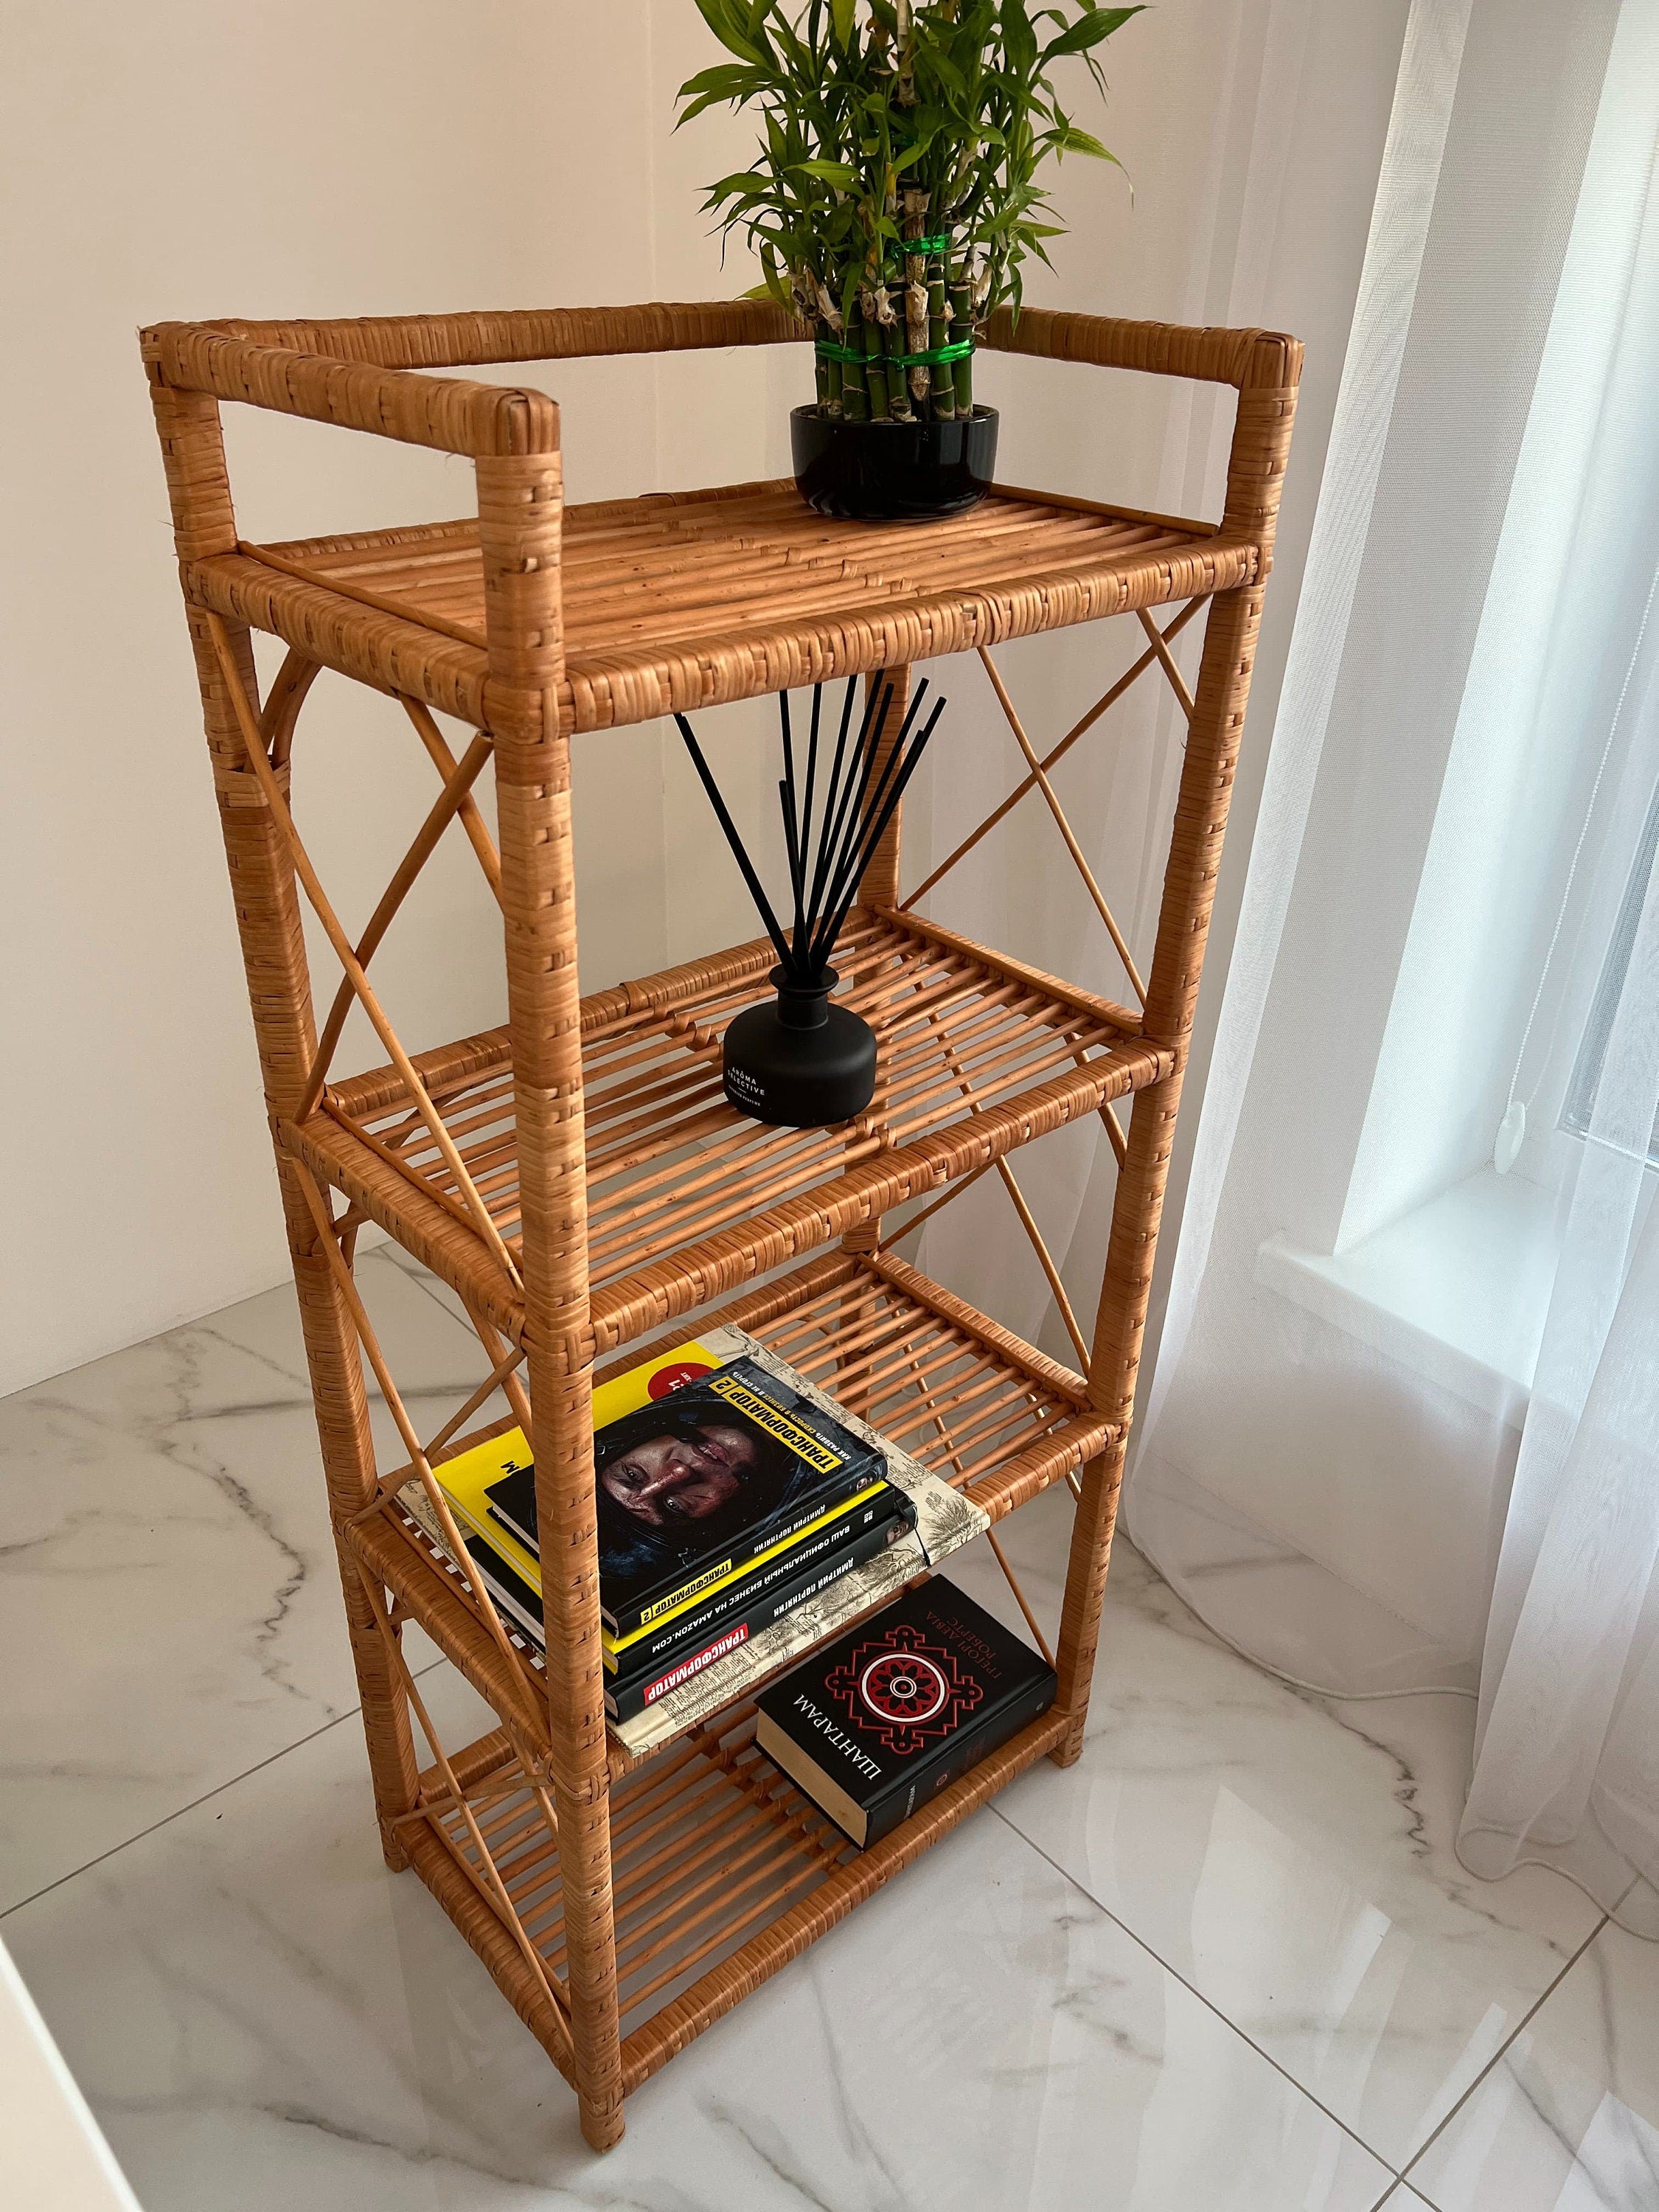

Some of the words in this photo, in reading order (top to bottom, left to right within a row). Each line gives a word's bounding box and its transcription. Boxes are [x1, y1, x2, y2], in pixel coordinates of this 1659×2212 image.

[727, 1069, 765, 1096] SELECTIVE
[716, 1380, 732, 1390] 2
[732, 1371, 754, 1387] СГОРЕТЬ
[751, 1383, 760, 1392] НЕ
[728, 1391, 835, 1470] ТРАНСФОРМАТОР
[790, 1413, 817, 1434] СКОРОСТЬ
[815, 1432, 841, 1453] РАЗВИТЬ
[838, 1450, 852, 1461] КАК
[754, 1526, 792, 1554] ПОРТНЯГИН
[831, 1525, 850, 1543] ВАШ
[764, 1538, 830, 1585] ОФИЦИАЛЬНЫЙ
[818, 1557, 855, 1590] ДМИТРИЙ
[655, 1562, 730, 1615] ТРАНСФОРМАТОР
[728, 1579, 762, 1606] БИЗНЕС
[773, 1583, 816, 1618] ПОРТНЯГИН
[643, 1611, 650, 1621] 2
[714, 1601, 728, 1615] НА
[652, 1610, 713, 1654] AMAZON.COM
[947, 1616, 996, 1660] РОБЕРТС
[647, 1627, 748, 1701] ТРАНСФОРМАТОР
[793, 1694, 883, 1781] ШАНТАРАМ
